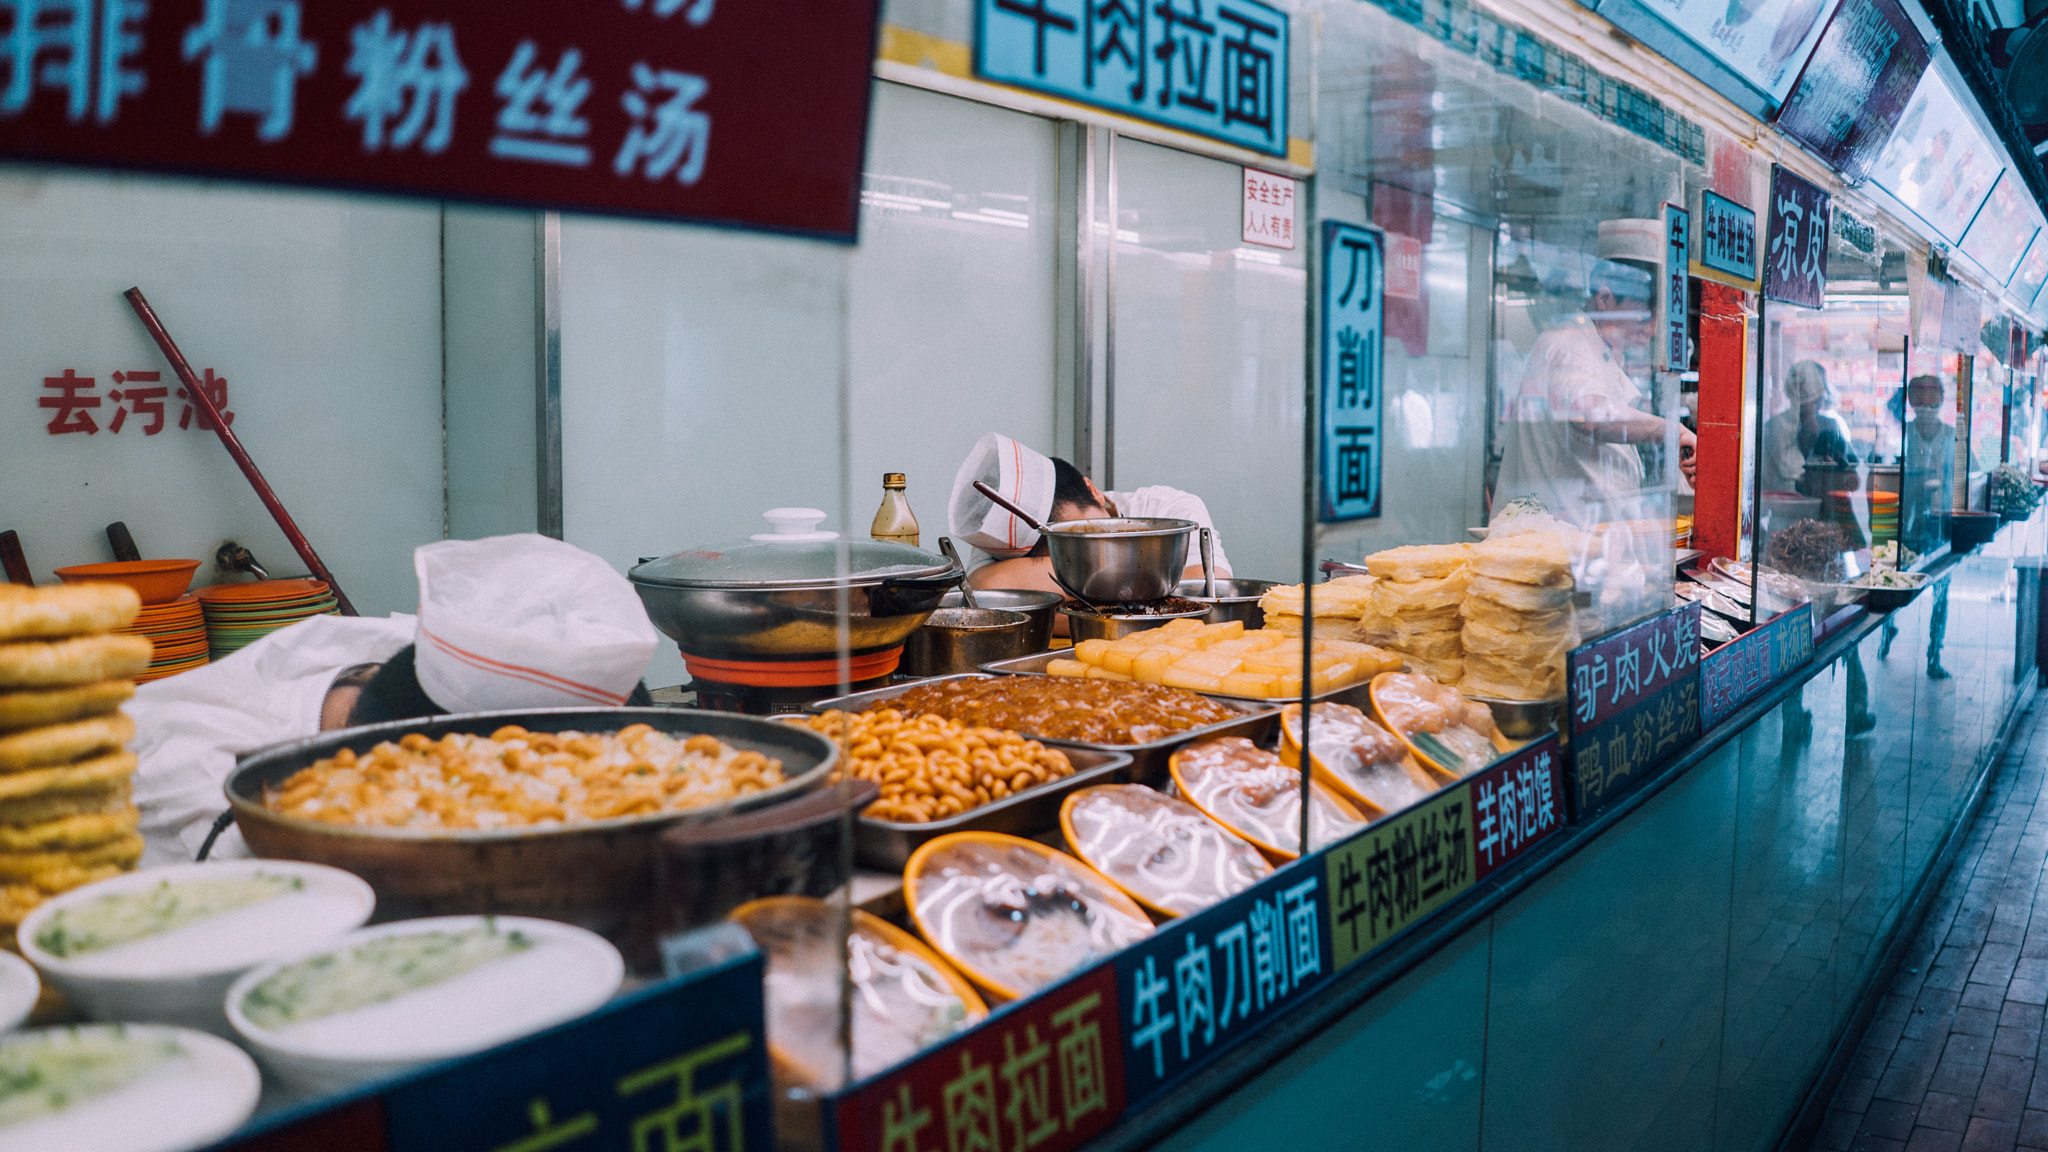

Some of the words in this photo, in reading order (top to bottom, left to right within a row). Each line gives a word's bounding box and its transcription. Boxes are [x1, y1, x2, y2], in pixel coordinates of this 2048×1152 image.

[1245, 210, 1292, 240] 人人有责
[1246, 176, 1293, 207] 安全生产
[1706, 202, 1754, 268] 牛肉粉丝汤
[1772, 189, 1826, 295] 凉皮
[1670, 214, 1686, 366] 牛肉面
[1334, 235, 1376, 506] 刀削面
[1575, 614, 1699, 724] 驴肉火烧
[1576, 682, 1698, 808] 鸭血粉丝汤
[1477, 750, 1555, 867] 羊肉泡馍
[1338, 801, 1468, 952] 牛肉粉丝汤
[1131, 875, 1321, 1078] 牛肉刀削面
